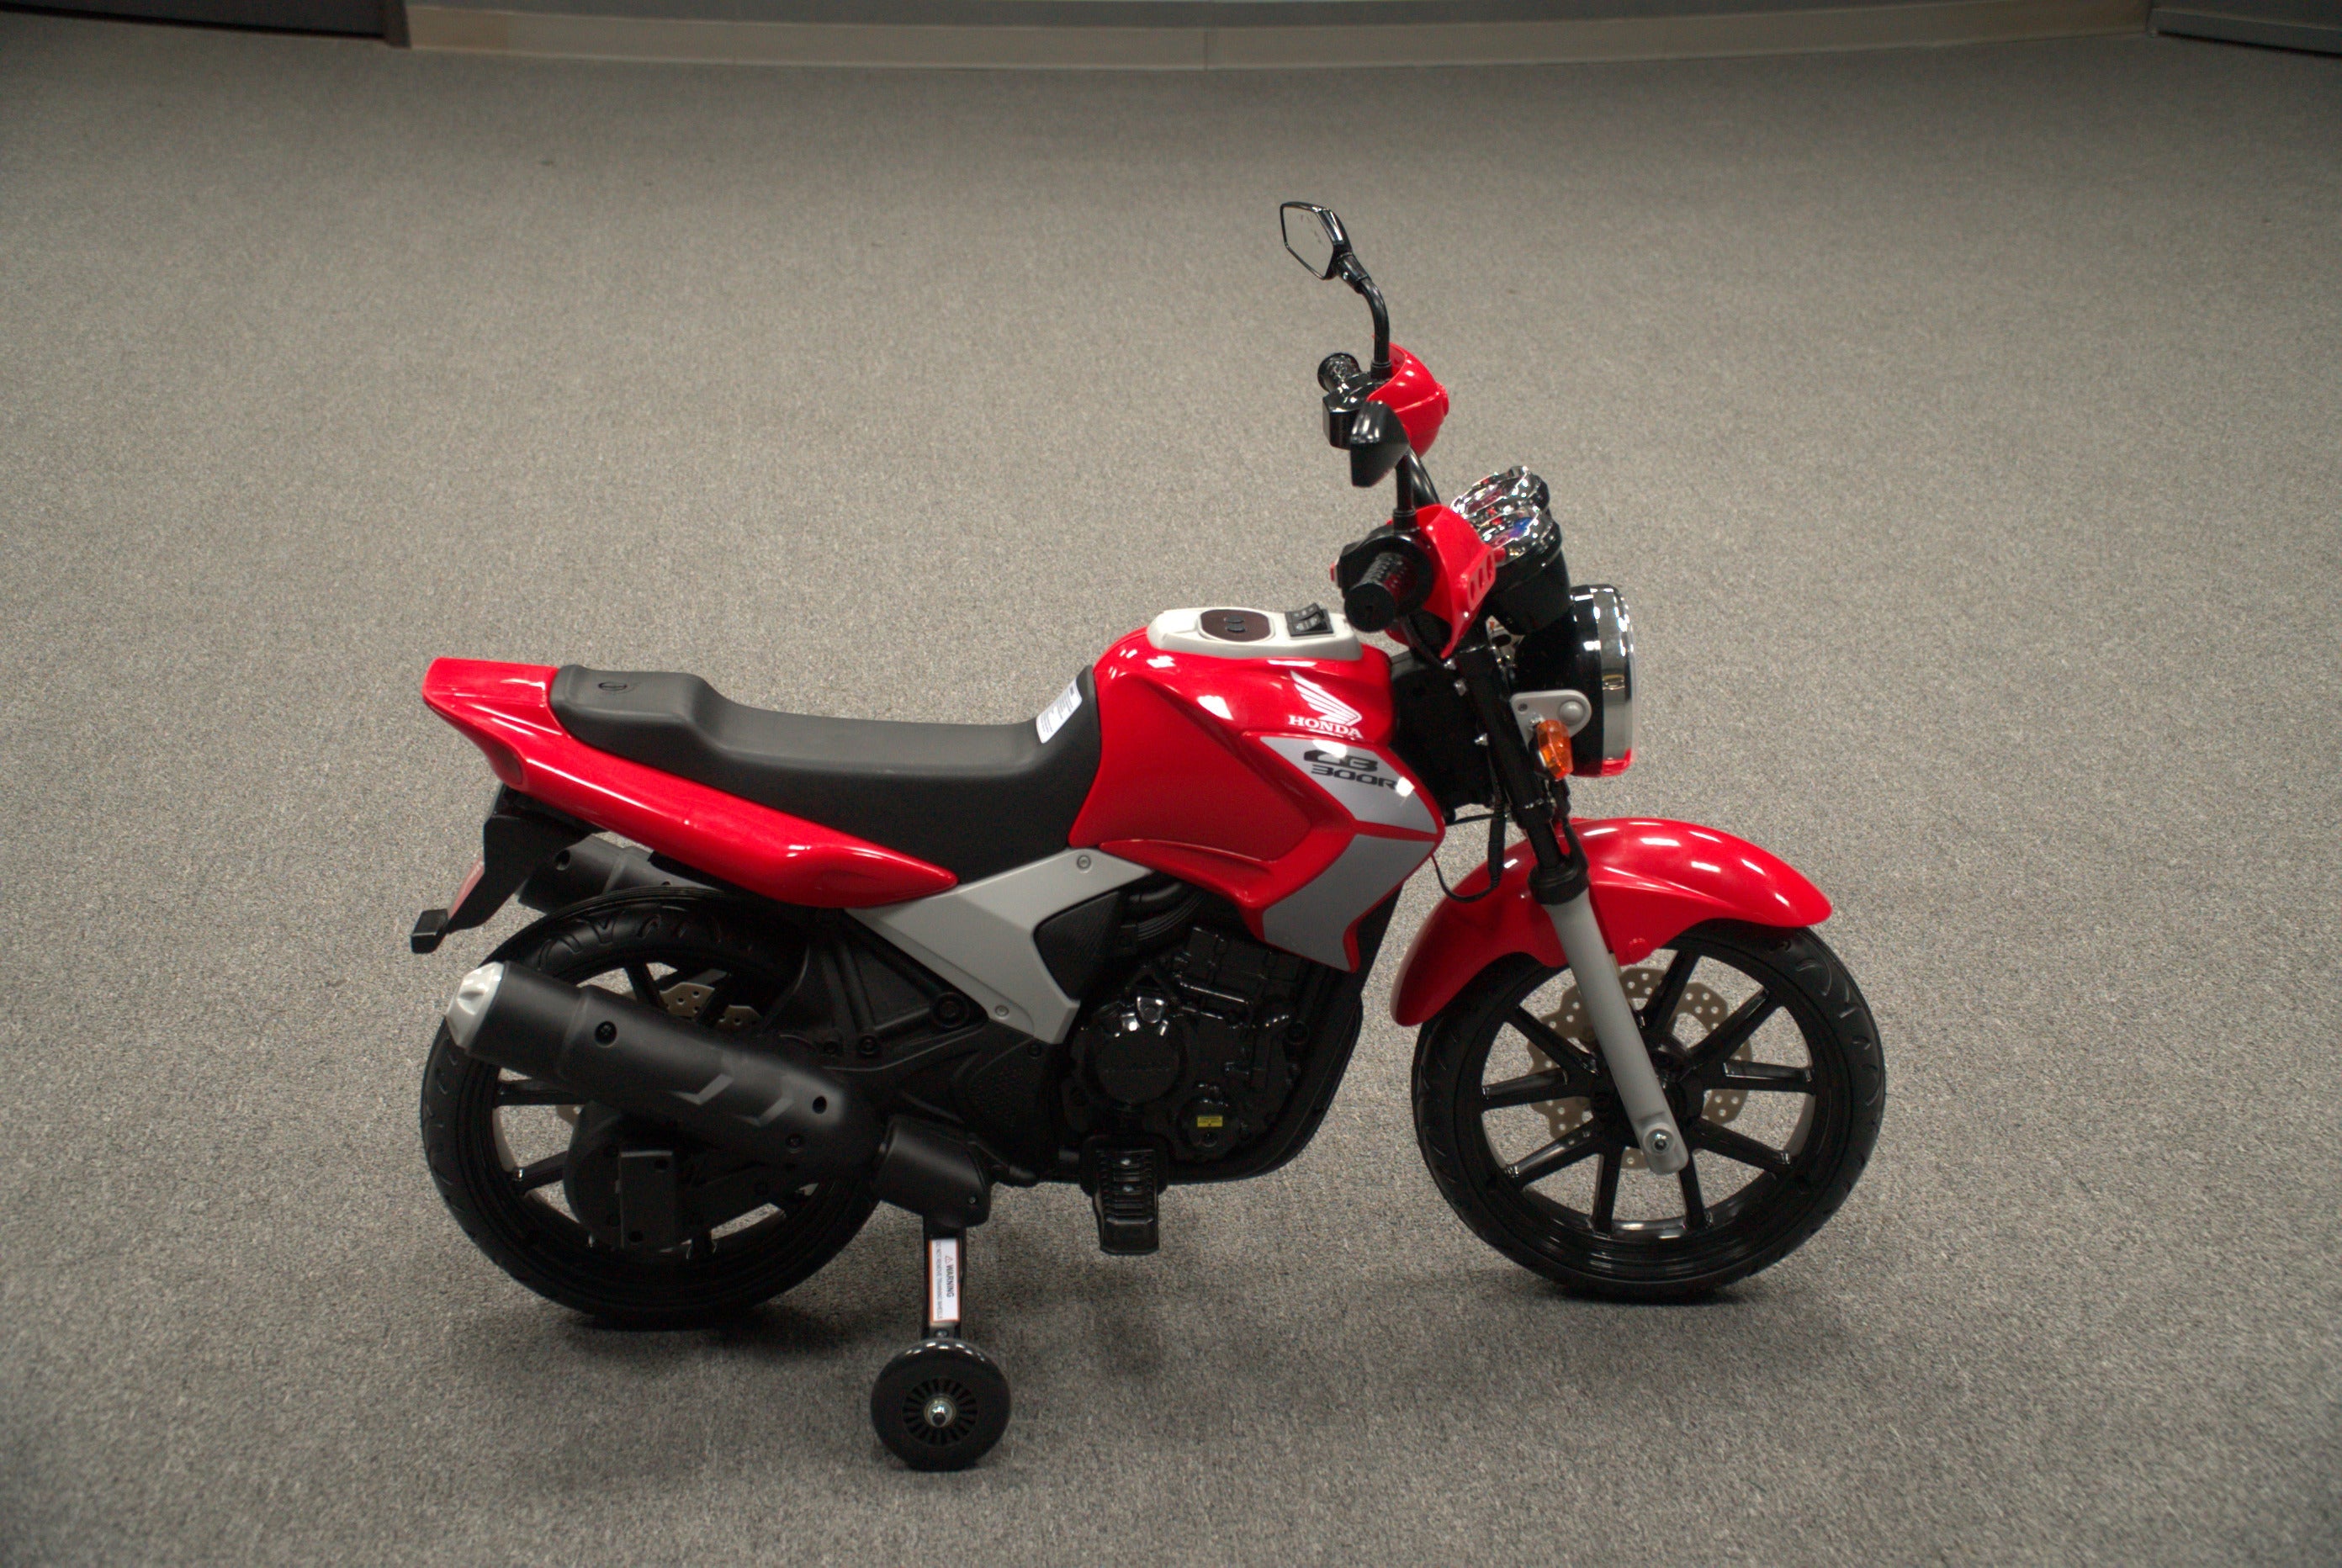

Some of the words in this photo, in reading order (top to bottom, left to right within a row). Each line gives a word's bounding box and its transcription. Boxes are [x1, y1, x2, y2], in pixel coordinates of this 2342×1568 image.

[1289, 715, 1364, 739] HONDA
[1304, 749, 1378, 772] CB
[1311, 764, 1398, 790] 300R
[946, 1264, 955, 1298] WARNING
